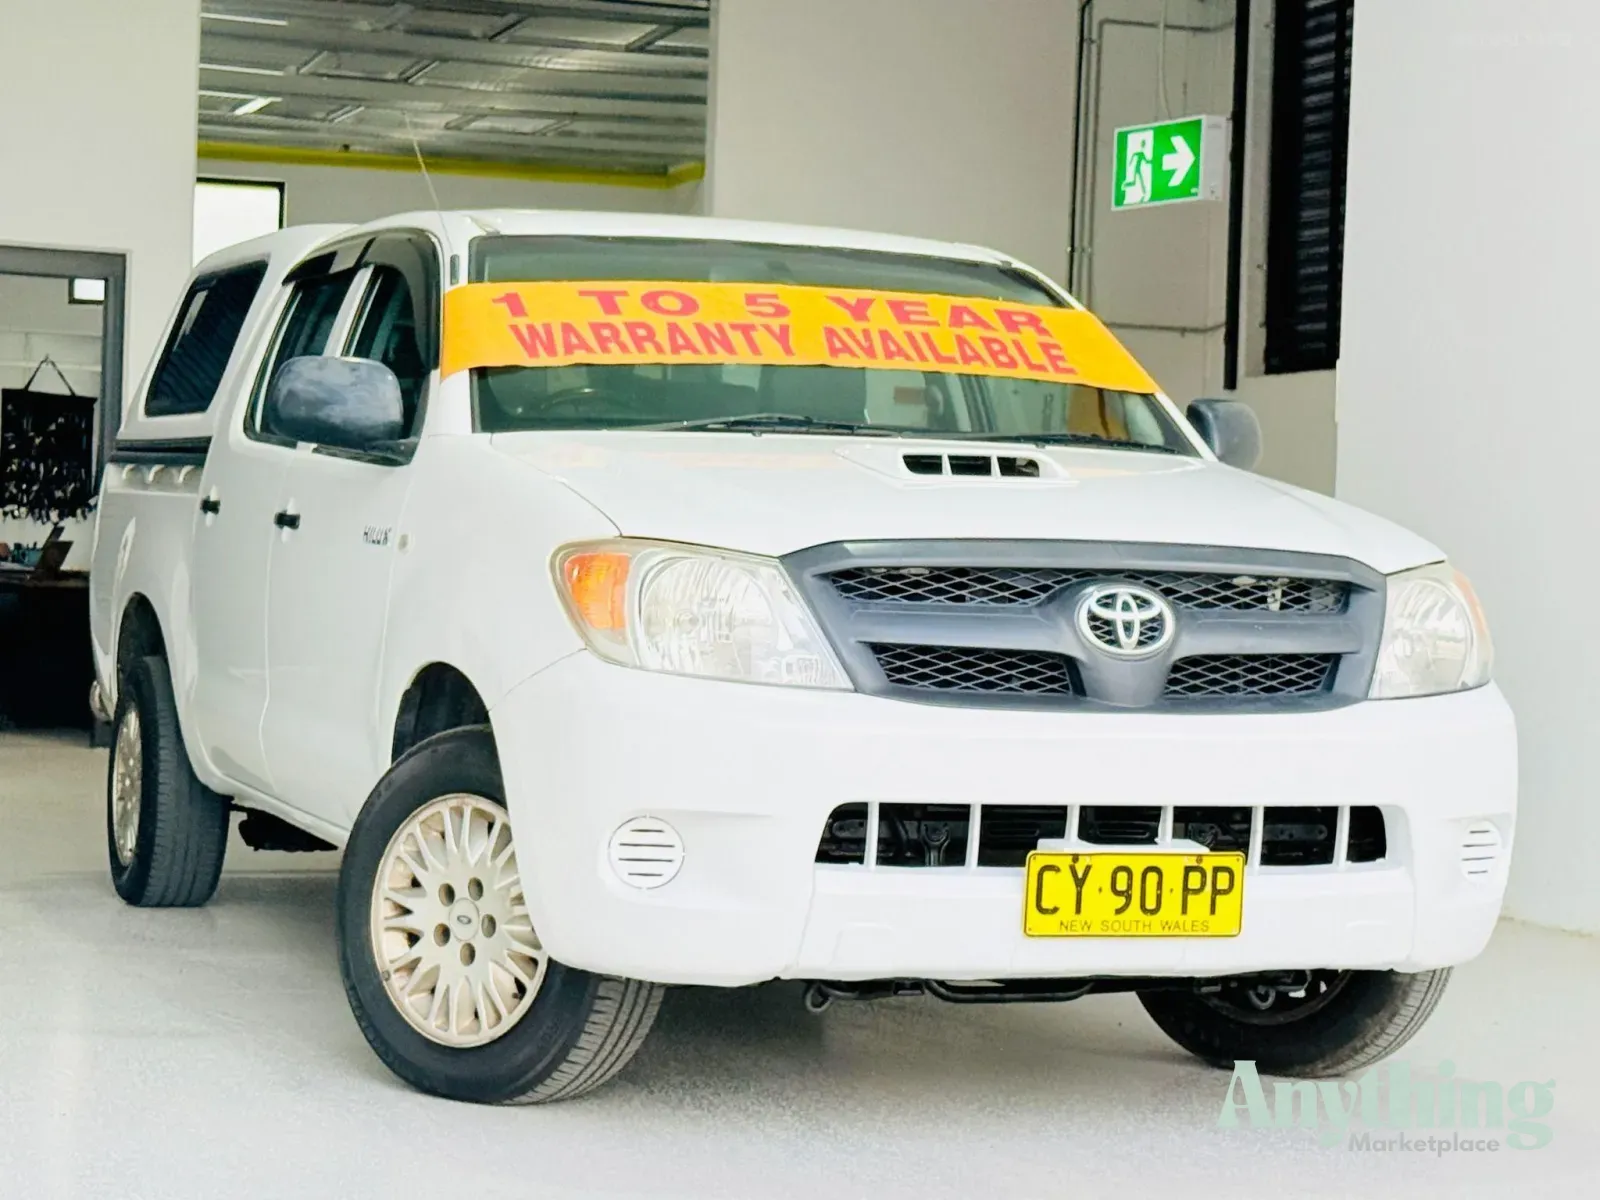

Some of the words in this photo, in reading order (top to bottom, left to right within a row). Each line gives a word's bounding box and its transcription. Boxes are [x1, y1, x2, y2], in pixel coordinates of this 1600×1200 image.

[492, 292, 528, 317] 1
[578, 290, 699, 316] TO
[744, 293, 790, 318] 5
[825, 296, 1054, 338] YEAR
[508, 322, 796, 358] WARRANTY
[823, 326, 1078, 375] AVAILABLE
[1059, 920, 1092, 933] NEW
[1100, 920, 1152, 933] SOUTH
[1160, 920, 1210, 933] WALES
